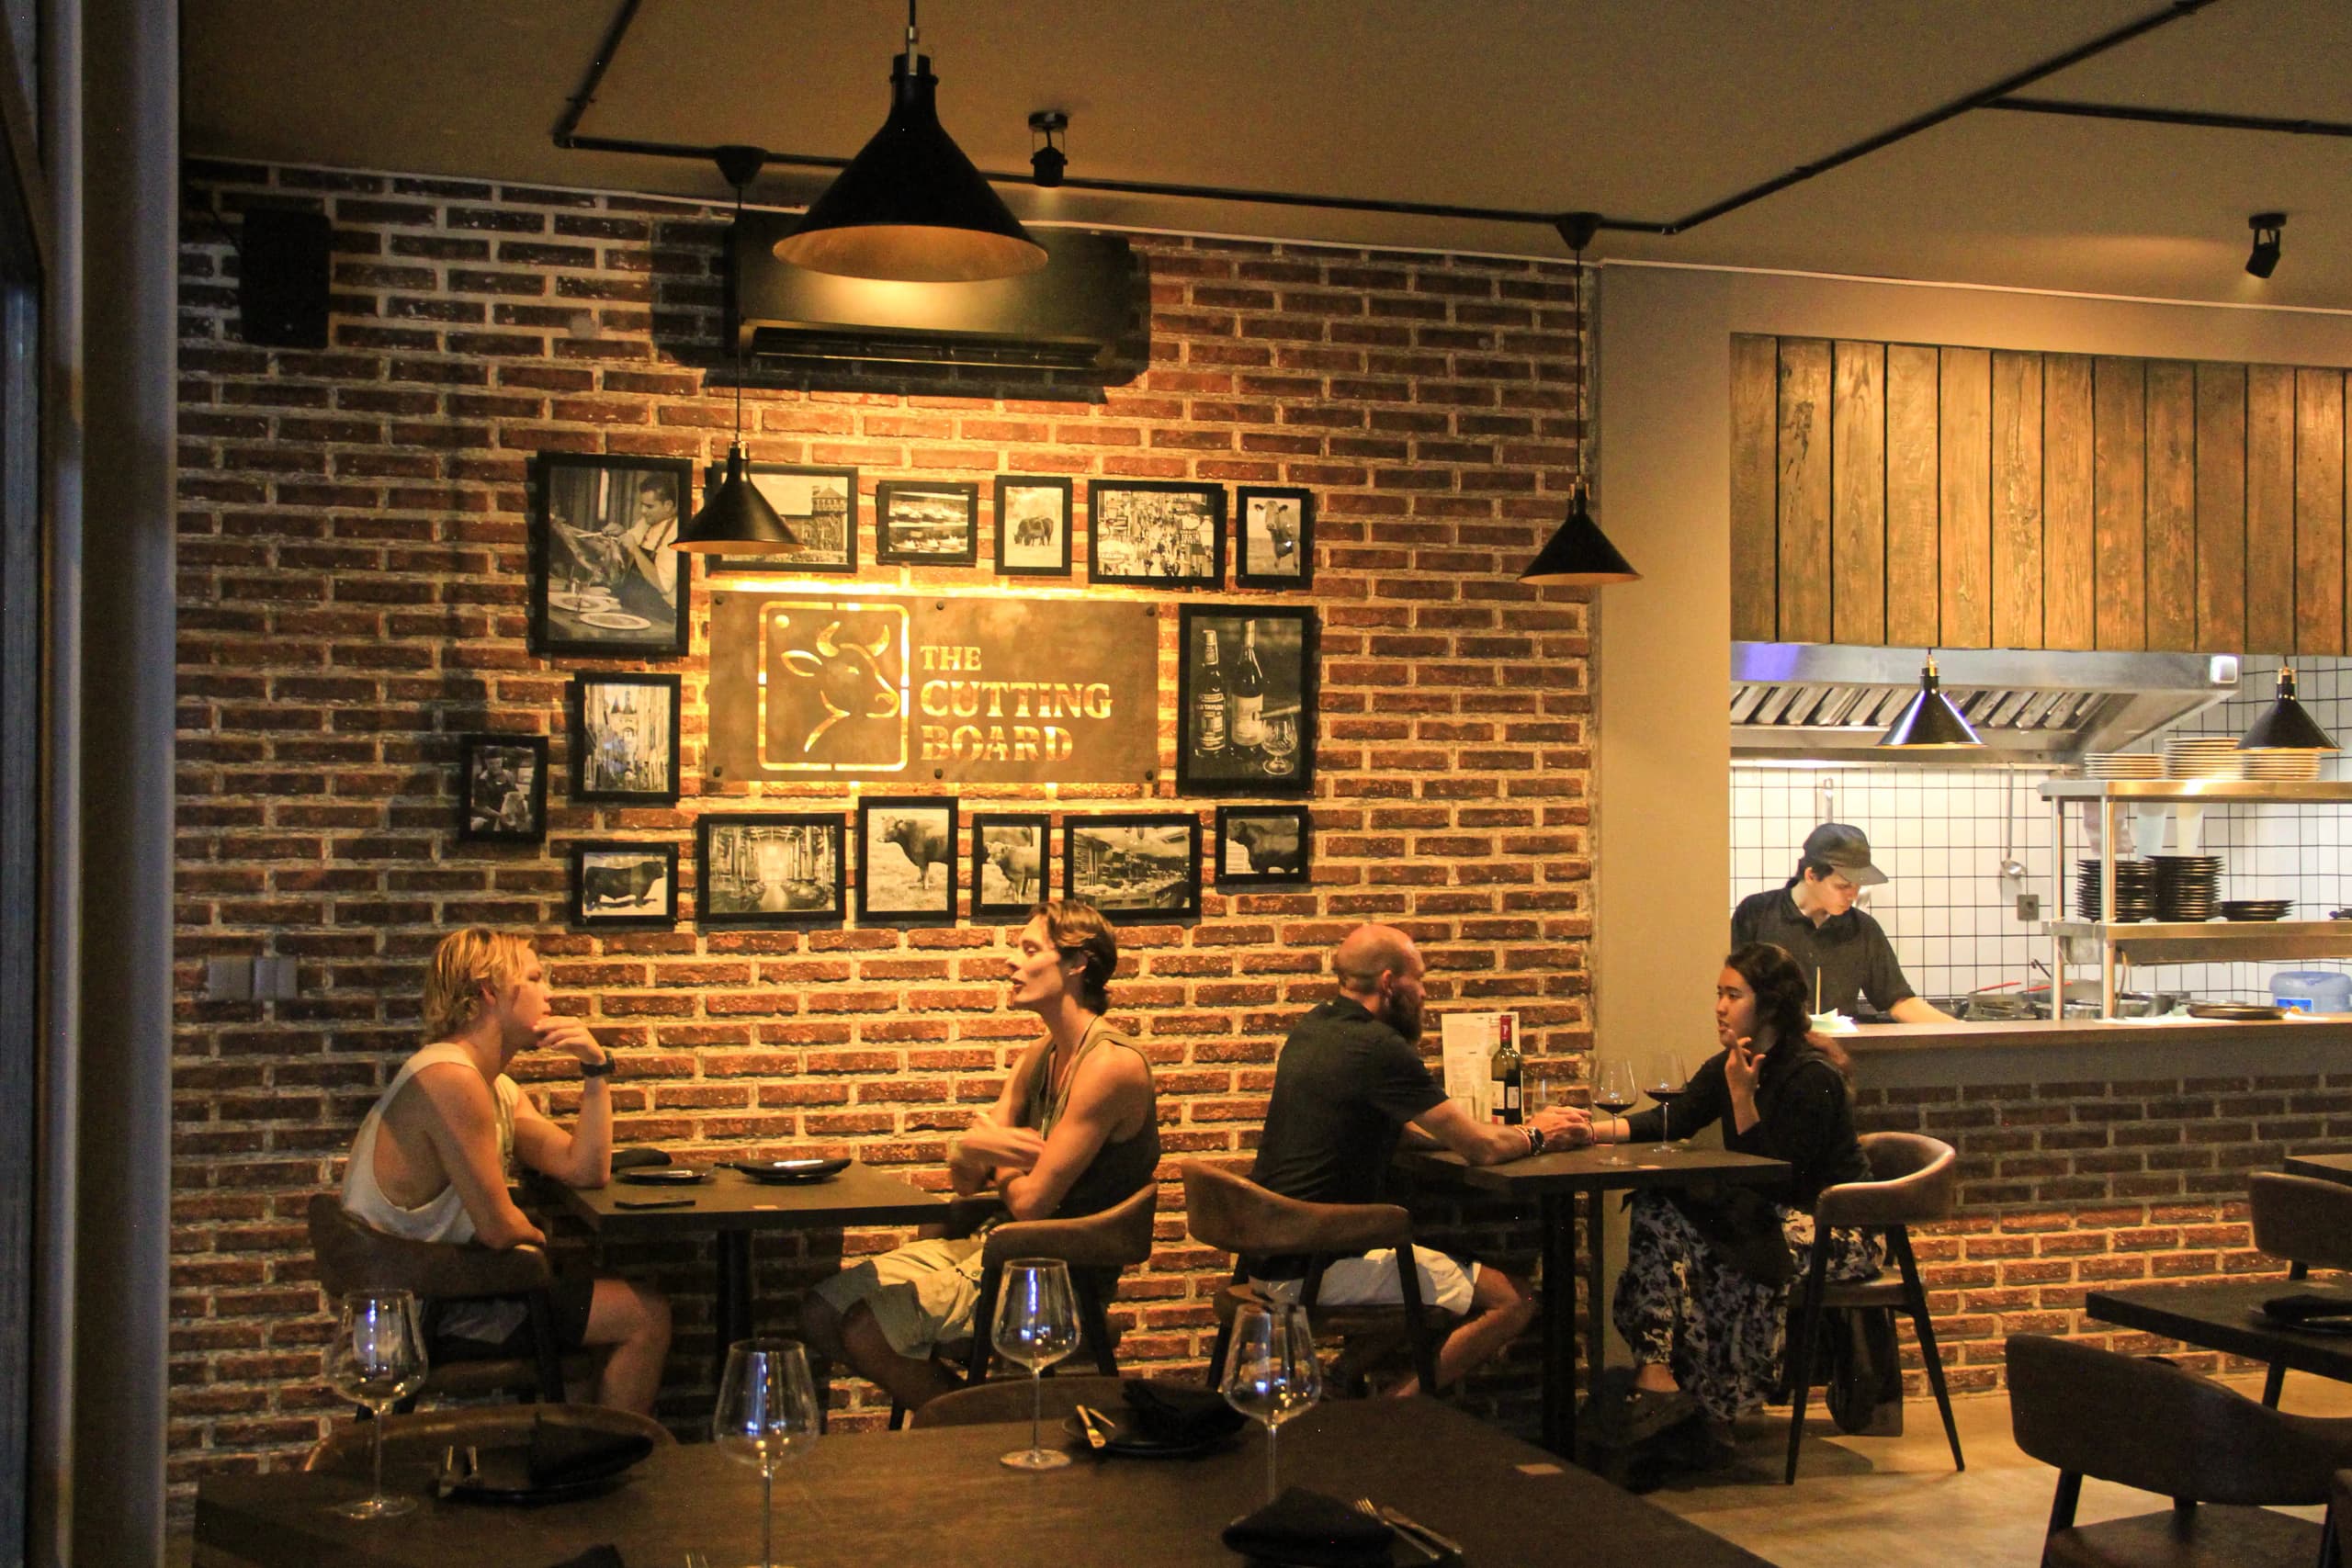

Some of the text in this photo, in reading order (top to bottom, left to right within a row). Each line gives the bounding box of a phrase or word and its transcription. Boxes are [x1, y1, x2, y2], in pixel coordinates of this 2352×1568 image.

[920, 646, 981, 671] THE
[920, 680, 1113, 718] CUTTING
[920, 725, 1073, 761] BOARD
